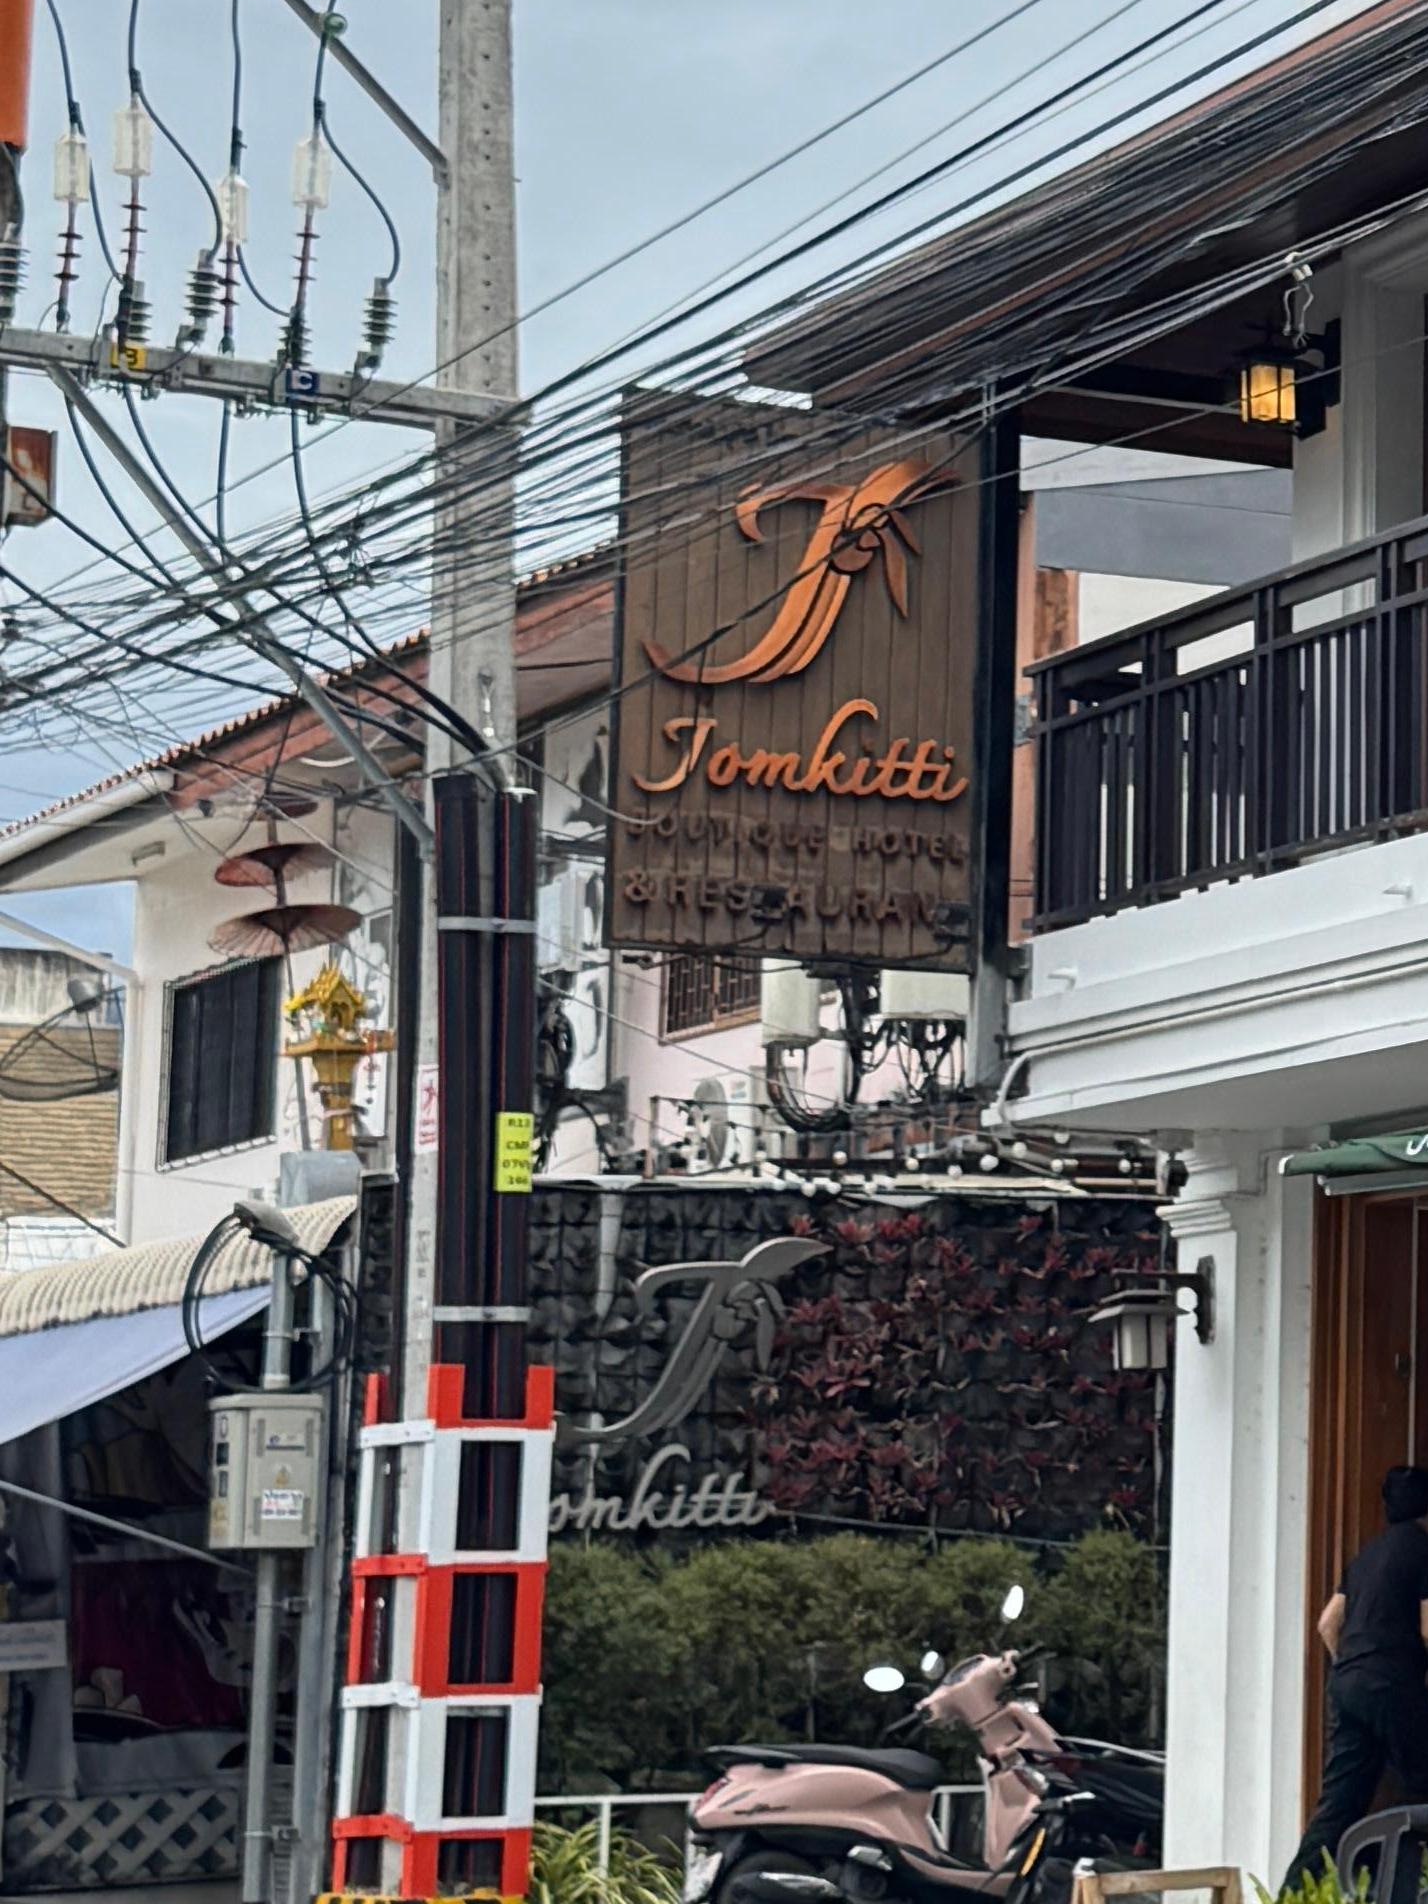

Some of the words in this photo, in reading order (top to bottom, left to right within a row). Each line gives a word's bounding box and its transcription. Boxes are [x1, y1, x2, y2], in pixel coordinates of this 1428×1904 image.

[633, 698, 970, 802] Jomkitti
[853, 823, 967, 865] HOTEL
[667, 874, 942, 928] RESAURAN
[548, 1443, 776, 1533] omkitti
